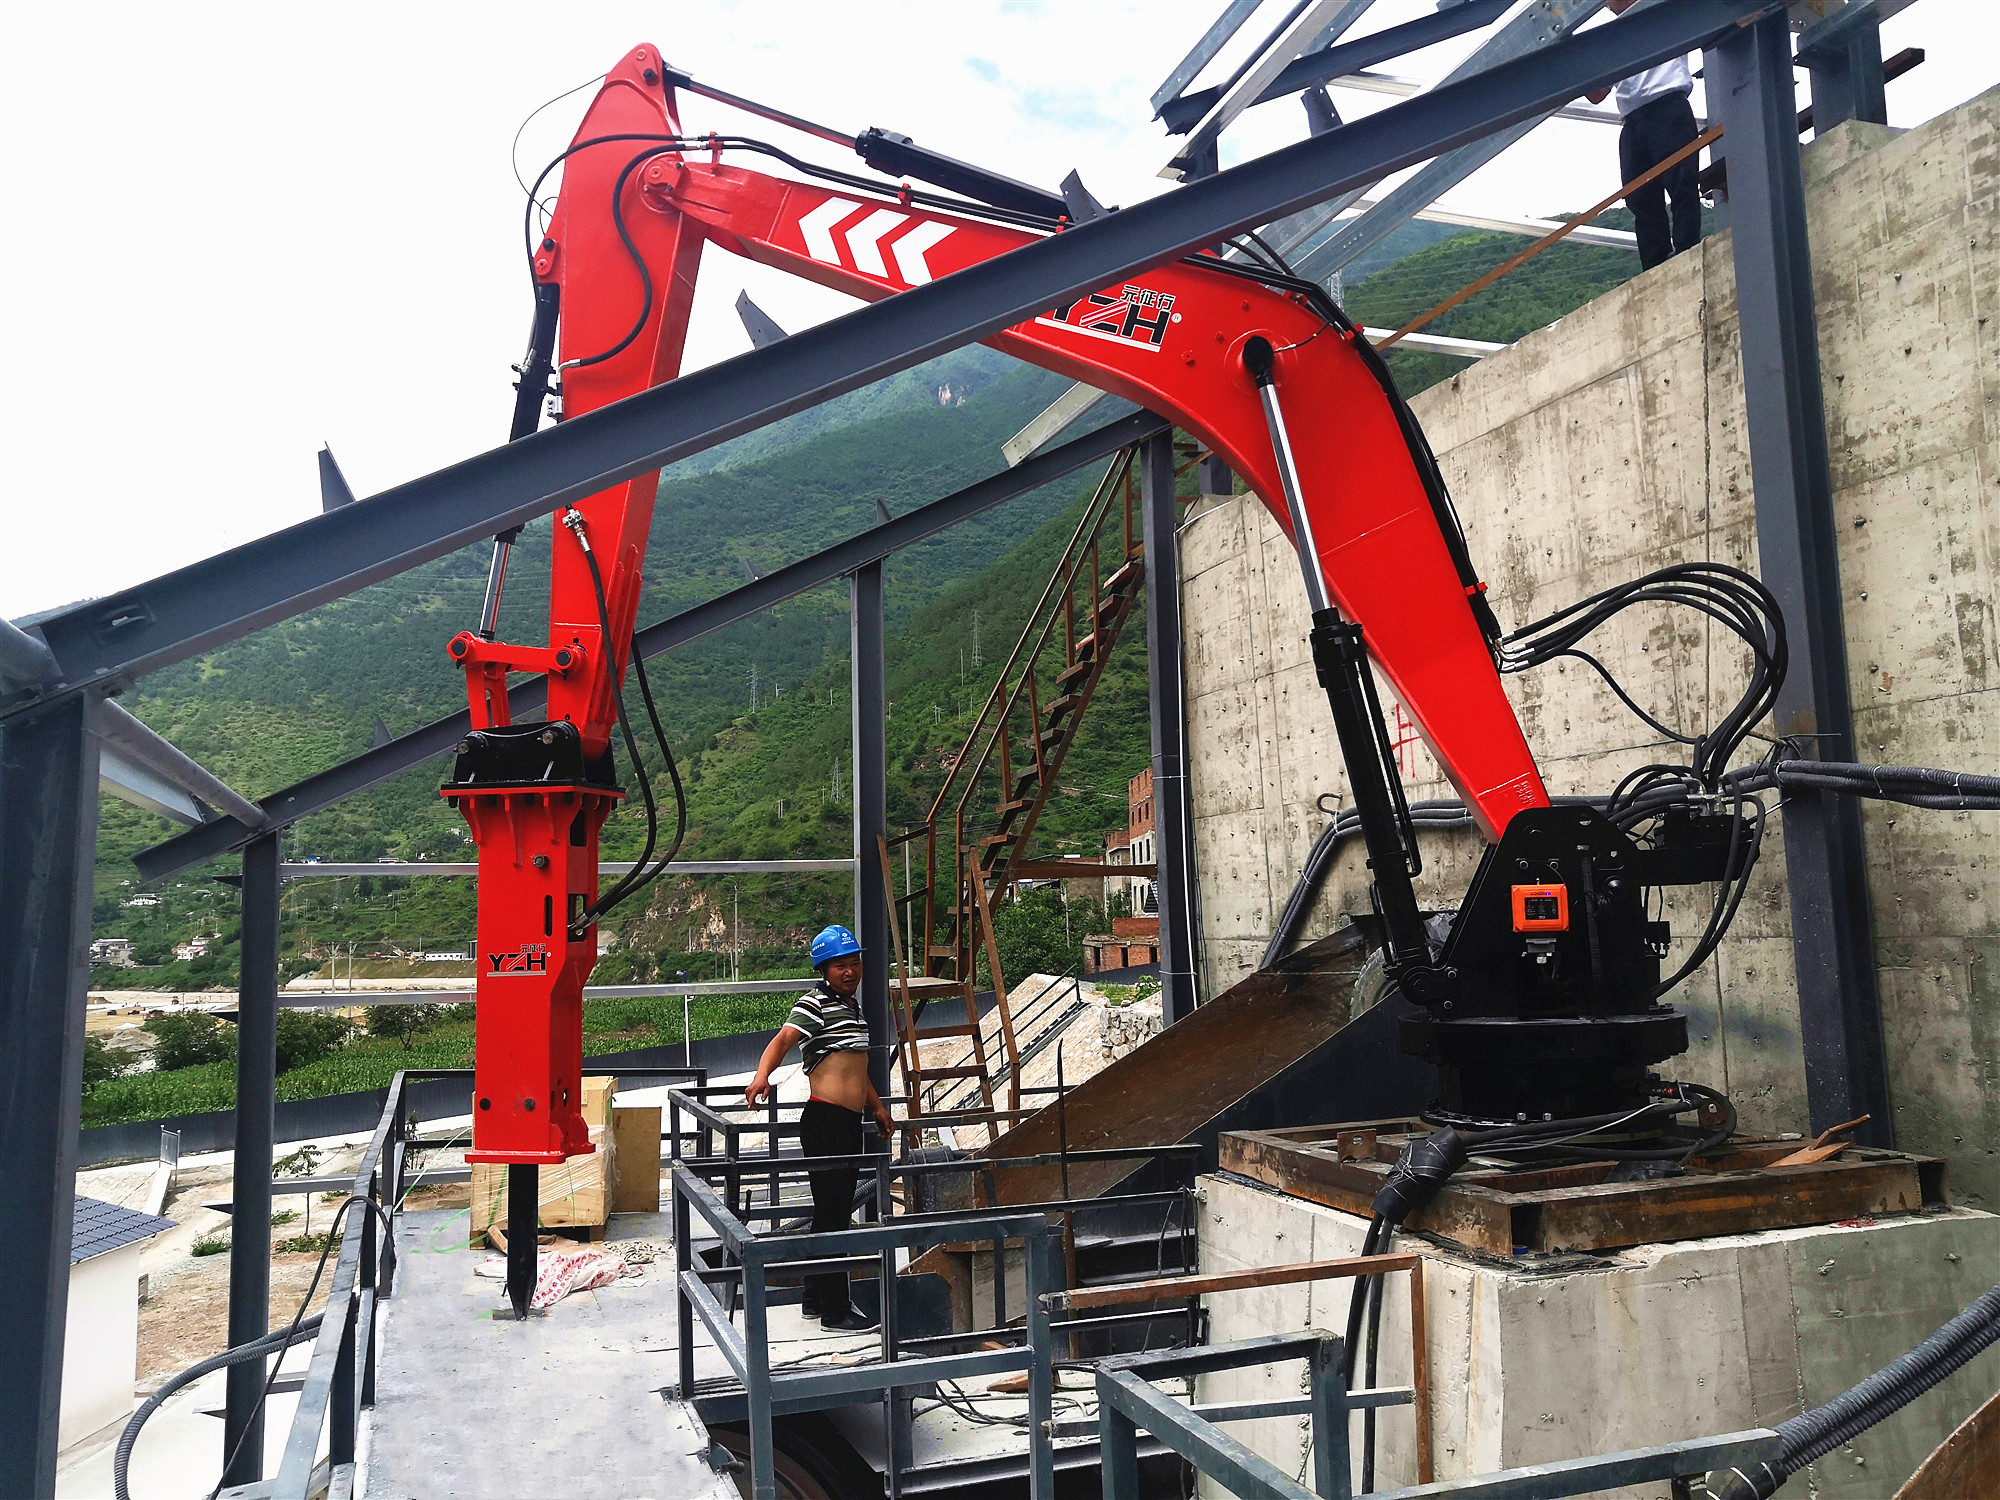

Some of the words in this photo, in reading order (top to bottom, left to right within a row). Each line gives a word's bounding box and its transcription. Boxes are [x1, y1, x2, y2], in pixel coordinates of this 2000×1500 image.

[1120, 284, 1176, 310] 元征行
[487, 952, 546, 972] YZH
